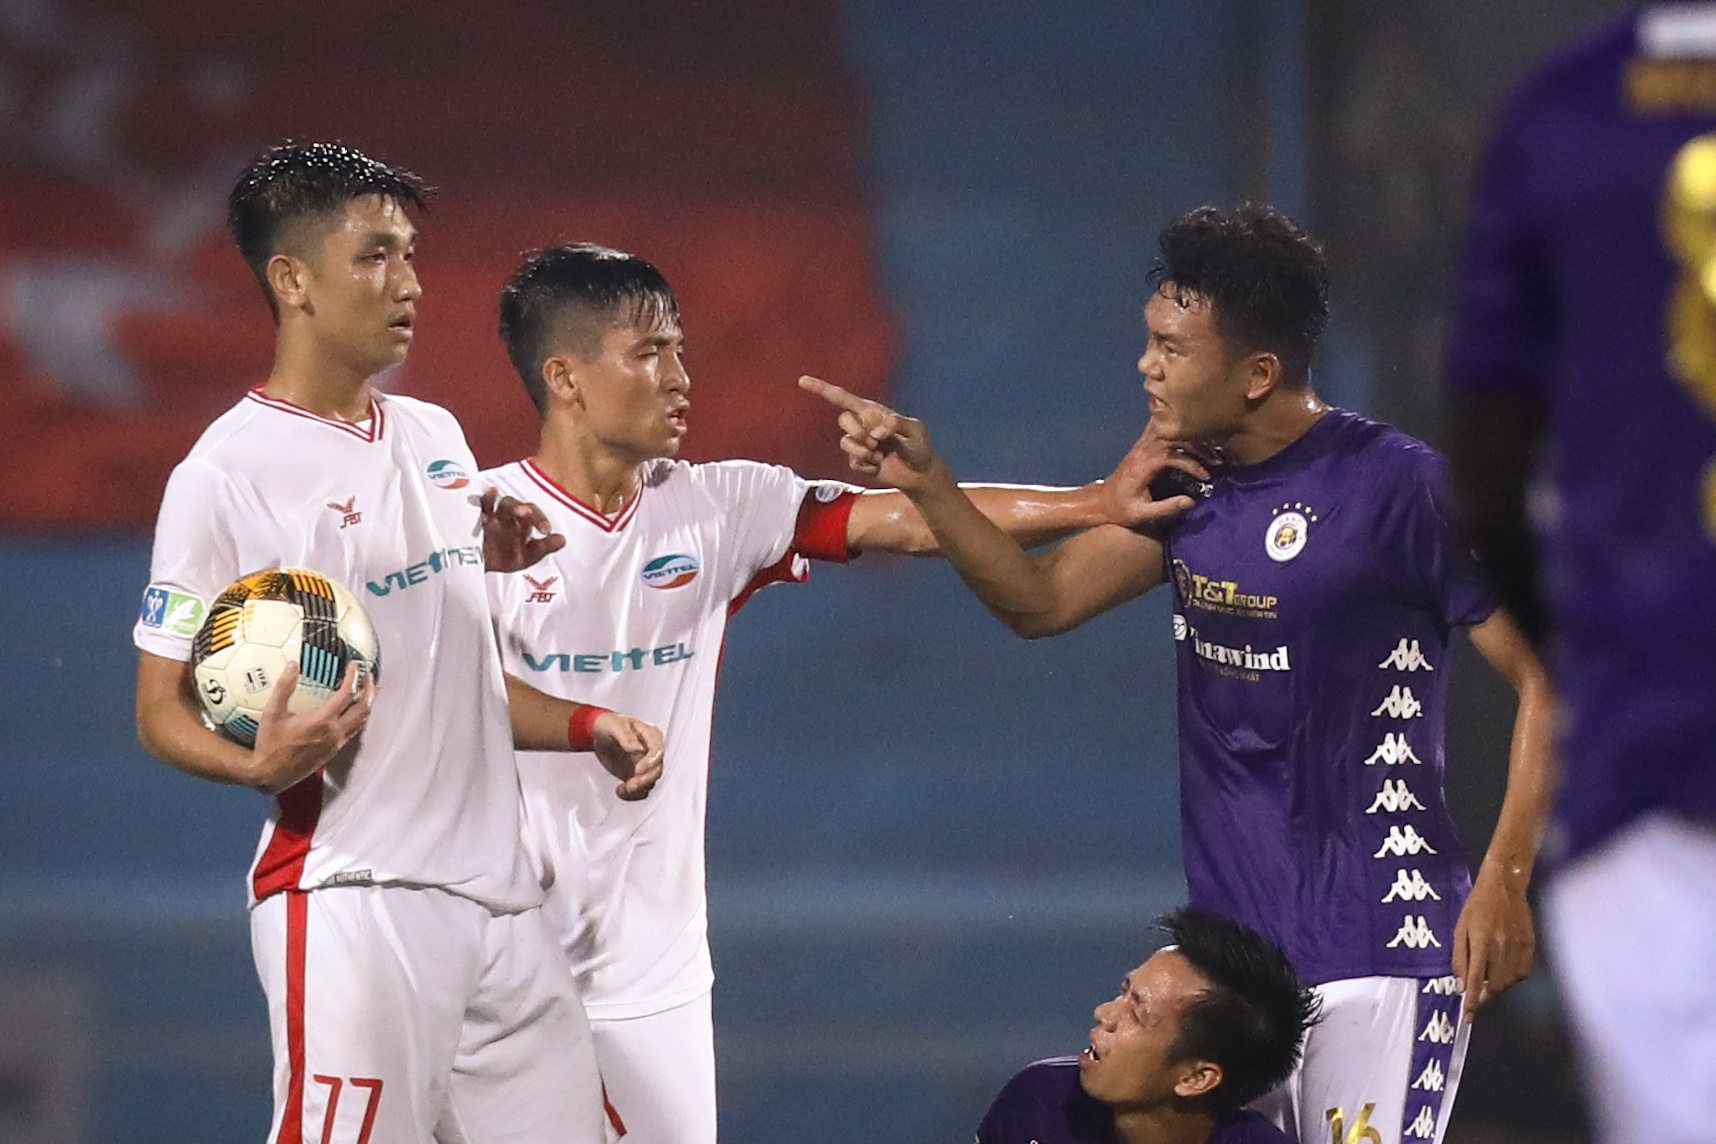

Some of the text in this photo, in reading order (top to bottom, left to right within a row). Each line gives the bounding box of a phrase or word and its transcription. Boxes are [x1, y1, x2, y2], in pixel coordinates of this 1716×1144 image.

[340, 511, 362, 529] FBT
[643, 564, 697, 580] VIETTEL
[525, 592, 556, 603] FBT
[1192, 574, 1238, 604] T&T
[1234, 594, 1278, 609] GROUP
[522, 642, 695, 672] VIETTEL
[255, 667, 268, 687] FIFA
[313, 1074, 384, 1144] 77
[1325, 1103, 1382, 1144] 16
